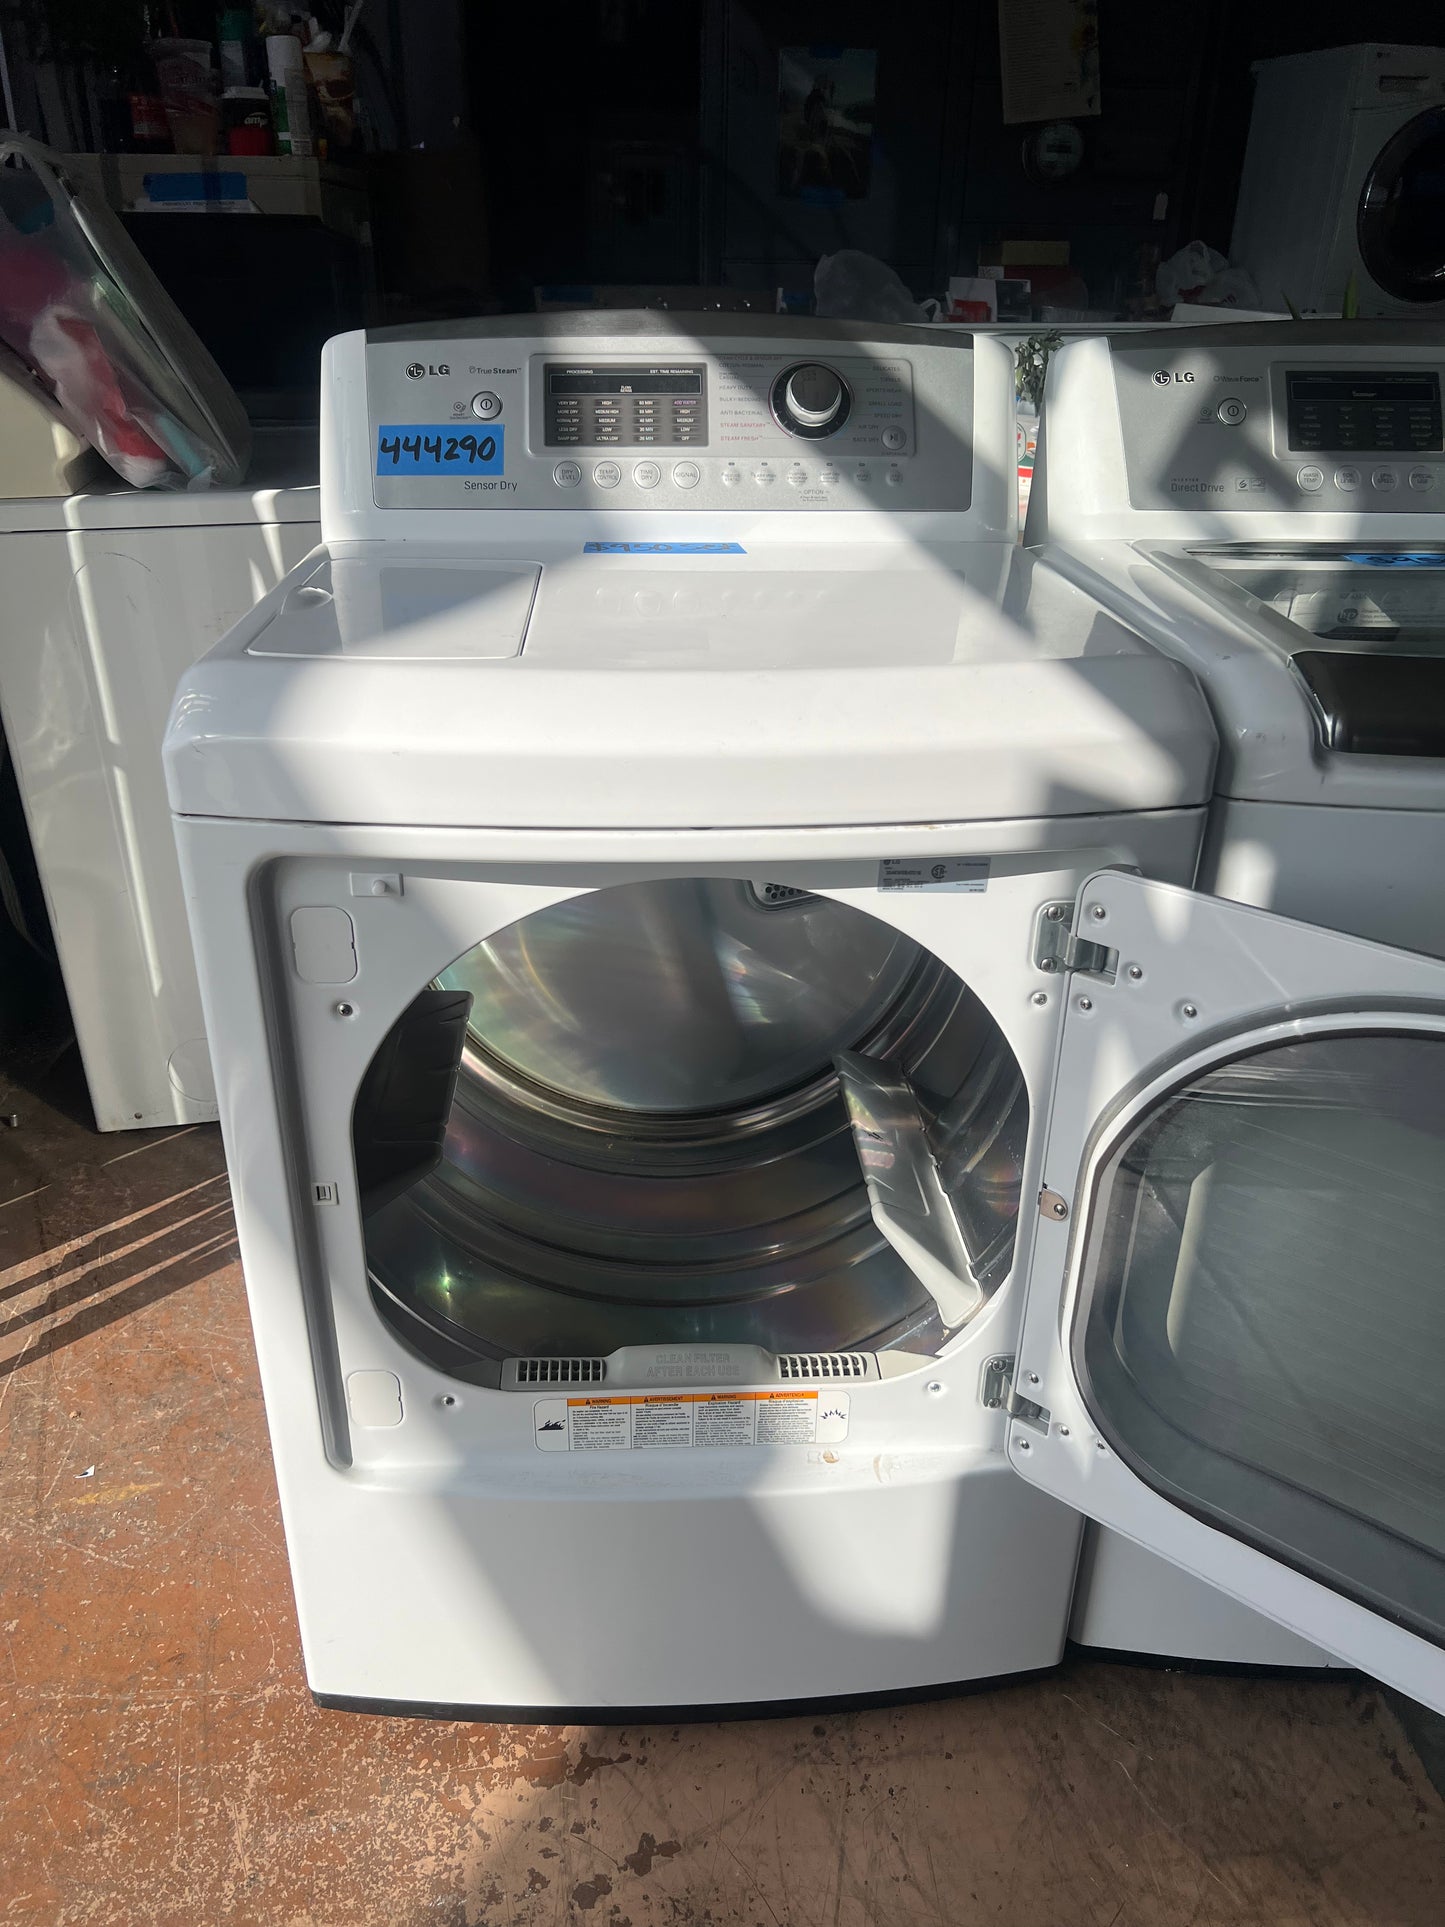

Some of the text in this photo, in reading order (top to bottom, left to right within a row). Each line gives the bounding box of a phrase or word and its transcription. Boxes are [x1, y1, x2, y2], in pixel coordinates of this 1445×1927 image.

[428, 364, 450, 376] LG
[1173, 371, 1195, 383] LG
[380, 434, 496, 465] 444290
[464, 480, 518, 492] Sensor Dry
[1170, 483, 1225, 493] Direct Drive
[655, 1352, 730, 1364] CLEAN FILTER
[646, 1365, 741, 1377] AFTER EACH USE
